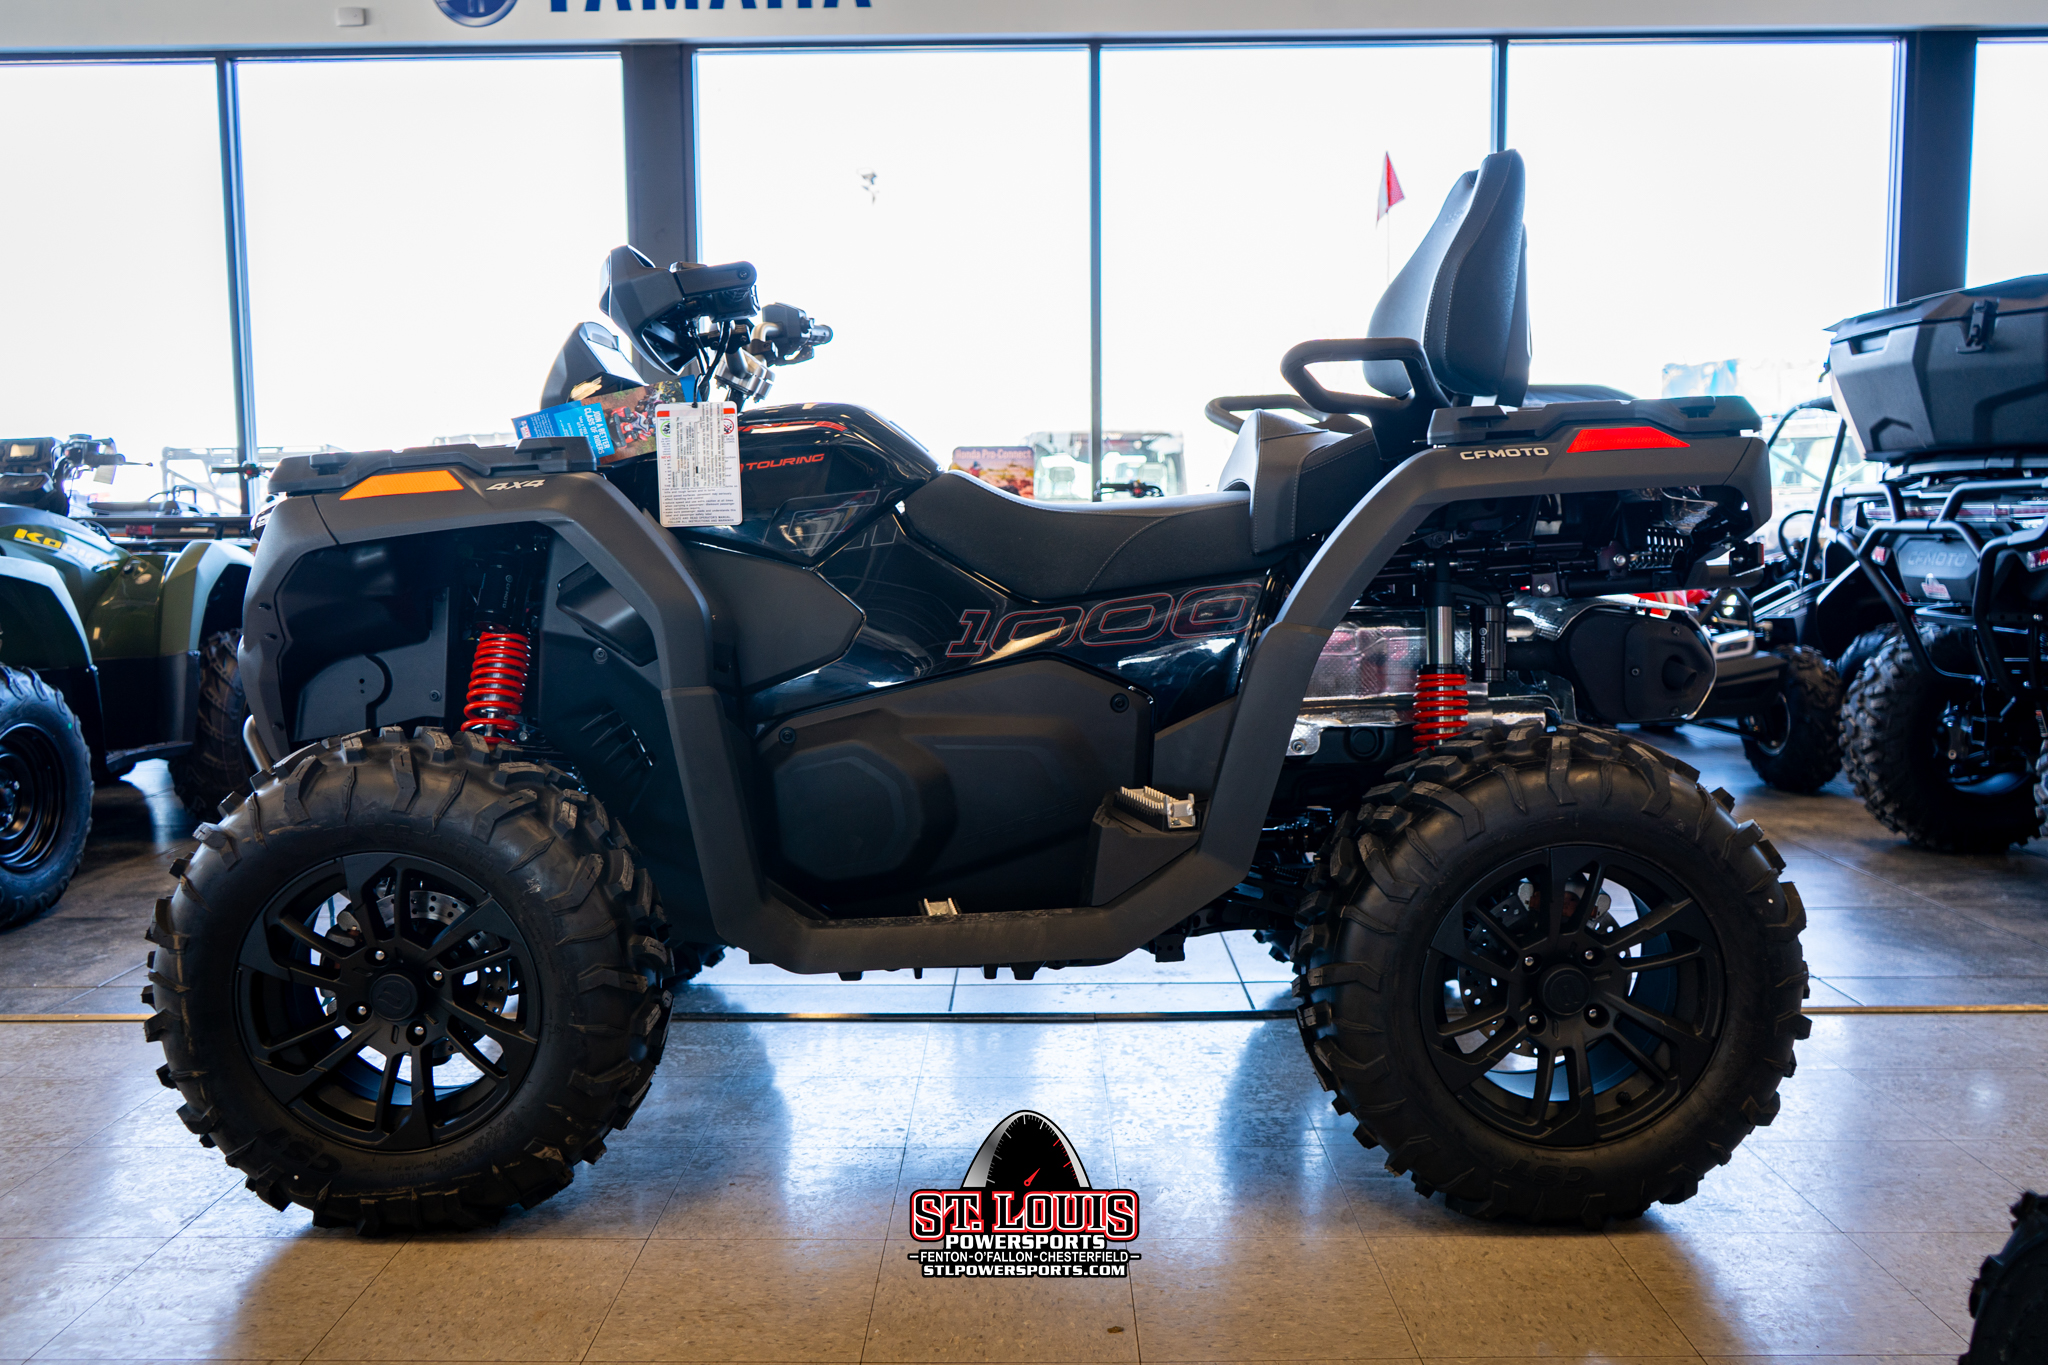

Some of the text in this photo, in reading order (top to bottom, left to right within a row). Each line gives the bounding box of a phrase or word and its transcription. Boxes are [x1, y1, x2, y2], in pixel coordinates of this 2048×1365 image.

[584, 408, 595, 426] CLASS
[593, 434, 605, 454] RIDERS
[593, 411, 602, 422] JOIN
[598, 428, 610, 449] BETTER
[746, 453, 825, 470] TOURING
[955, 449, 980, 459] Honda
[1460, 447, 1549, 460] CFMOTO
[1907, 551, 1968, 567] CFMOTO
[945, 582, 1262, 657] 1000
[1498, 1158, 1595, 1188] CST
